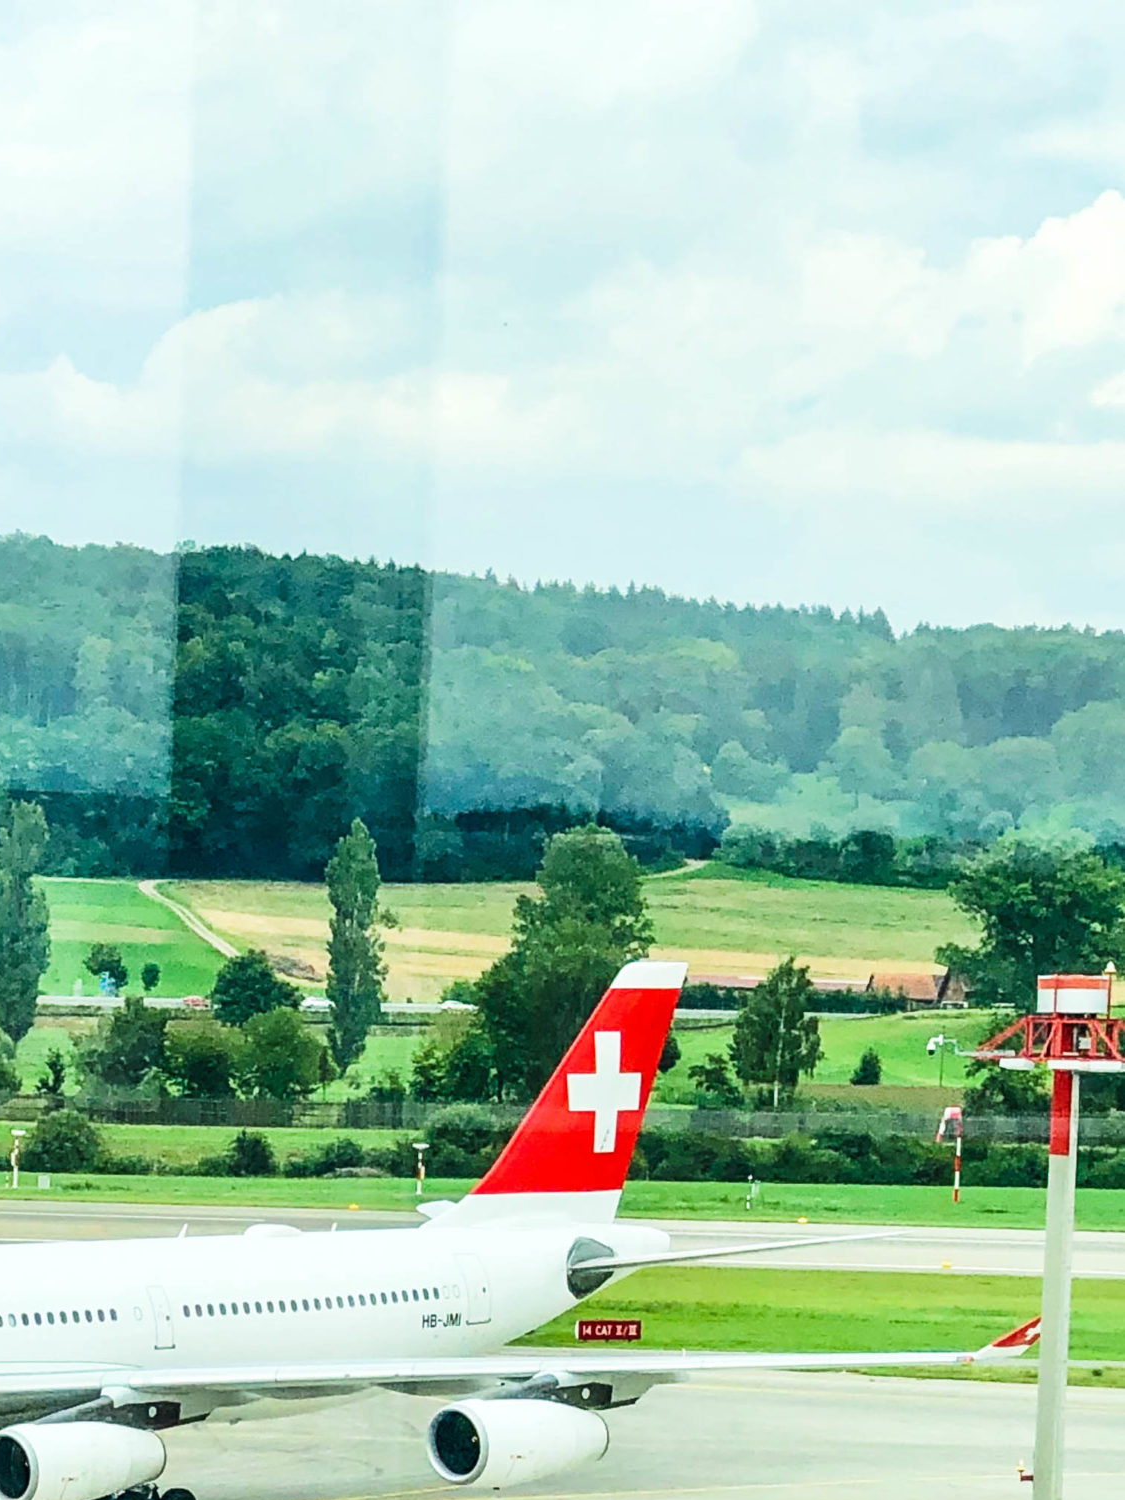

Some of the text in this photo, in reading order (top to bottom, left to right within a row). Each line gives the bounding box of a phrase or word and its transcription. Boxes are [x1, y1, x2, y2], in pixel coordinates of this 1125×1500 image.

[422, 1312, 462, 1328] HB-JMI
[582, 1325, 592, 1336] 14
[595, 1325, 613, 1336] CAT
